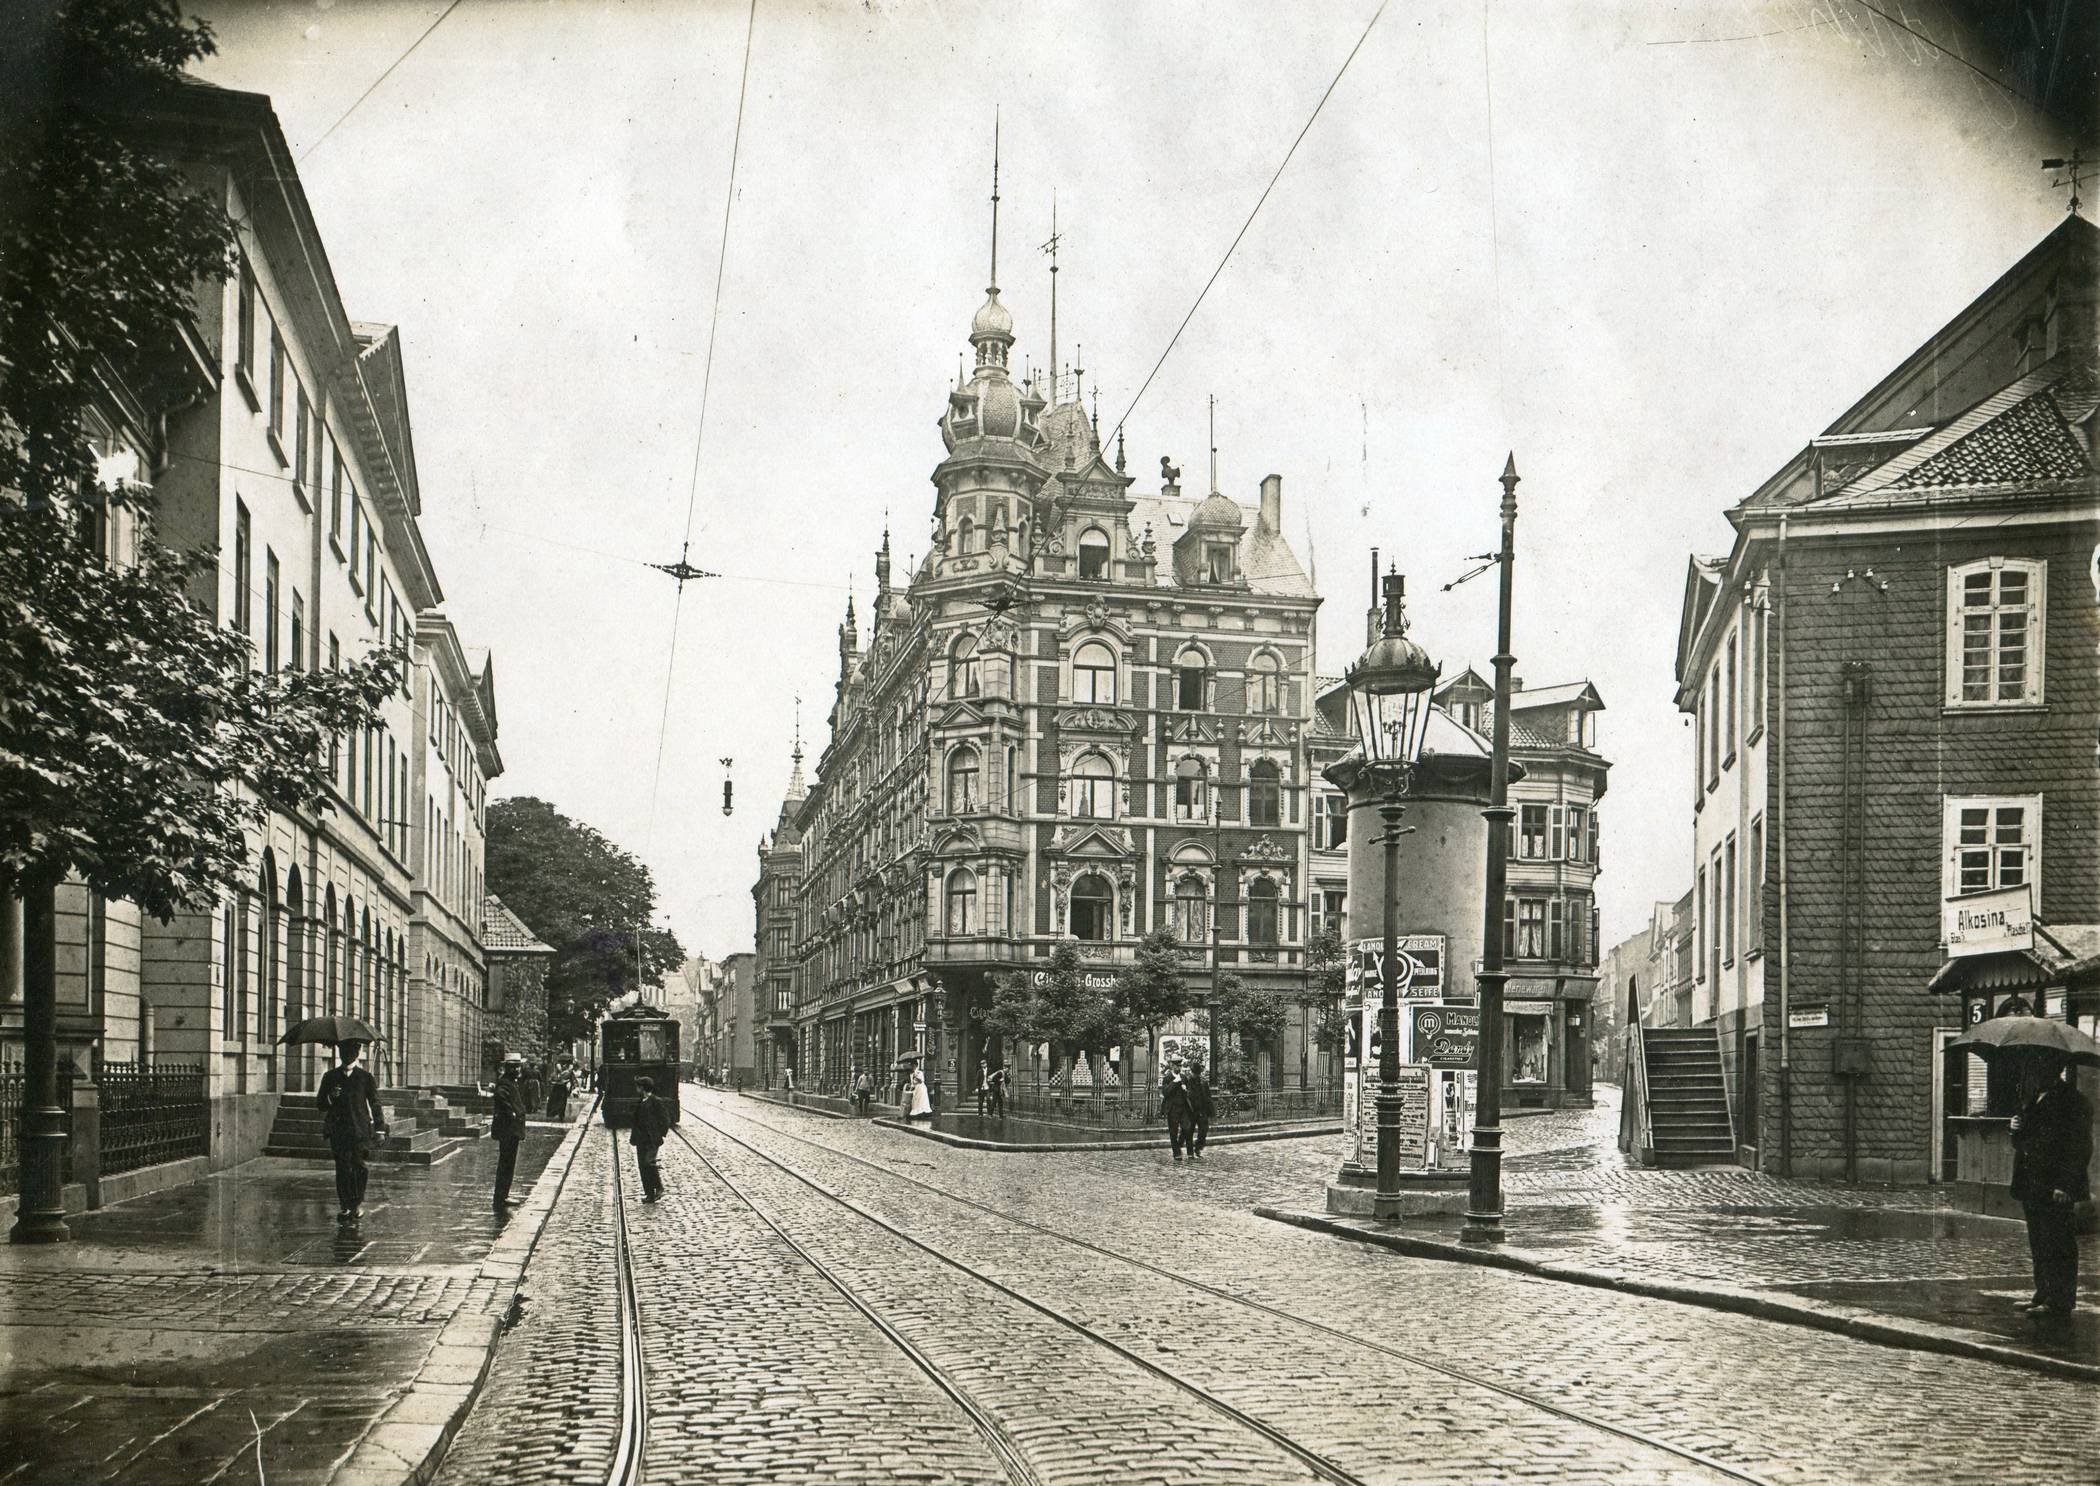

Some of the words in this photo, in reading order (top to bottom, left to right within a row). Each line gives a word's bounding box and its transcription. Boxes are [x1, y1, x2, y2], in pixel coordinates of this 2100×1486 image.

[1958, 909, 2005, 931] Alkosina
[1407, 939, 1437, 949] CREAM
[1411, 988, 1438, 997] SEIFE
[1971, 1004, 1982, 1024] 5
